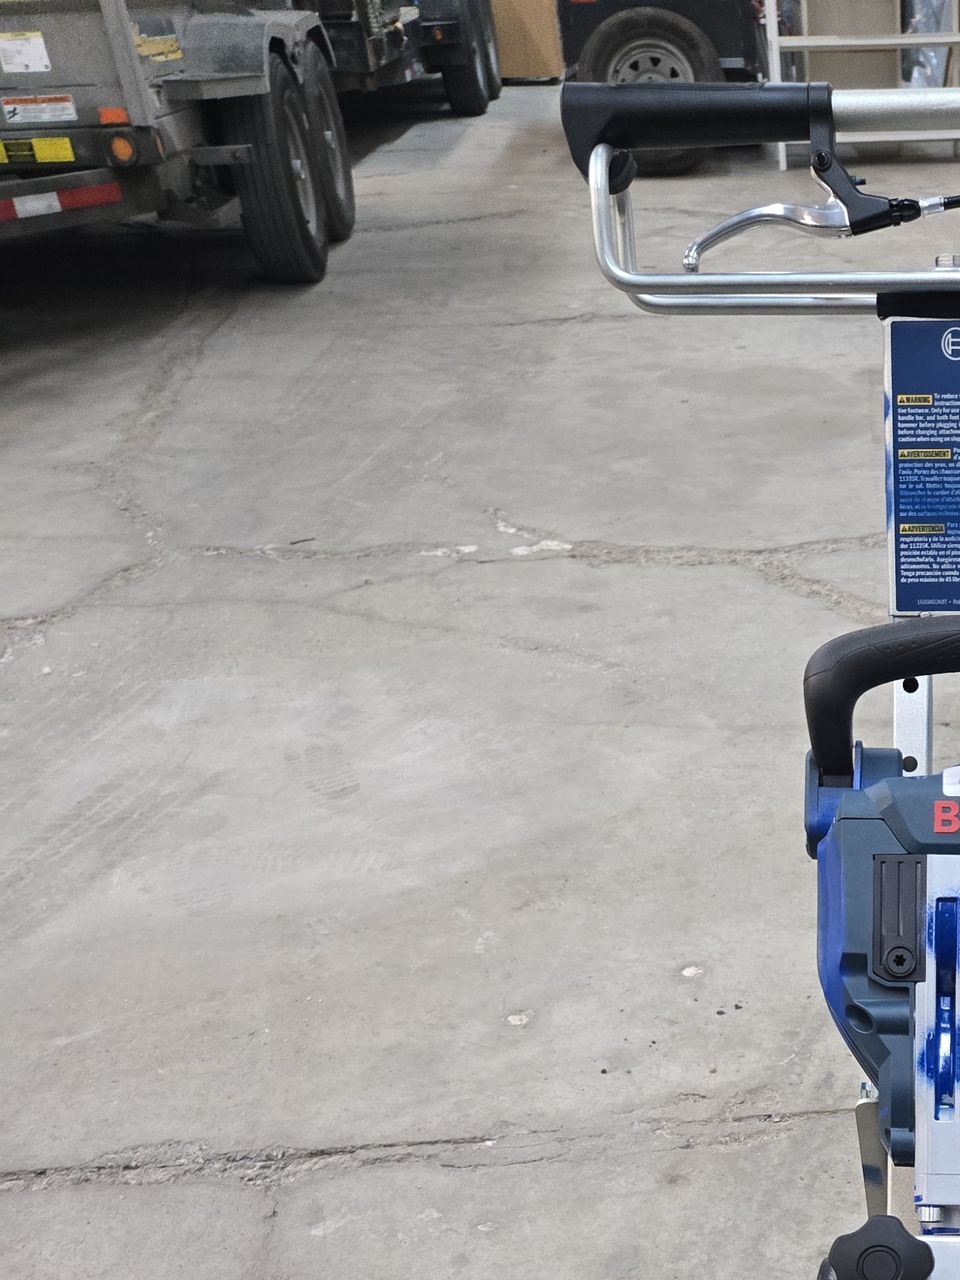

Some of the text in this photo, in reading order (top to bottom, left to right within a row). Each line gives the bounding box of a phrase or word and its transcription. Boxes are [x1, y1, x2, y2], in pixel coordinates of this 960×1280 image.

[905, 396, 932, 404] WARNING
[907, 450, 950, 458] AVERTISSEMENT
[907, 525, 944, 533] ADVERTENCIA
